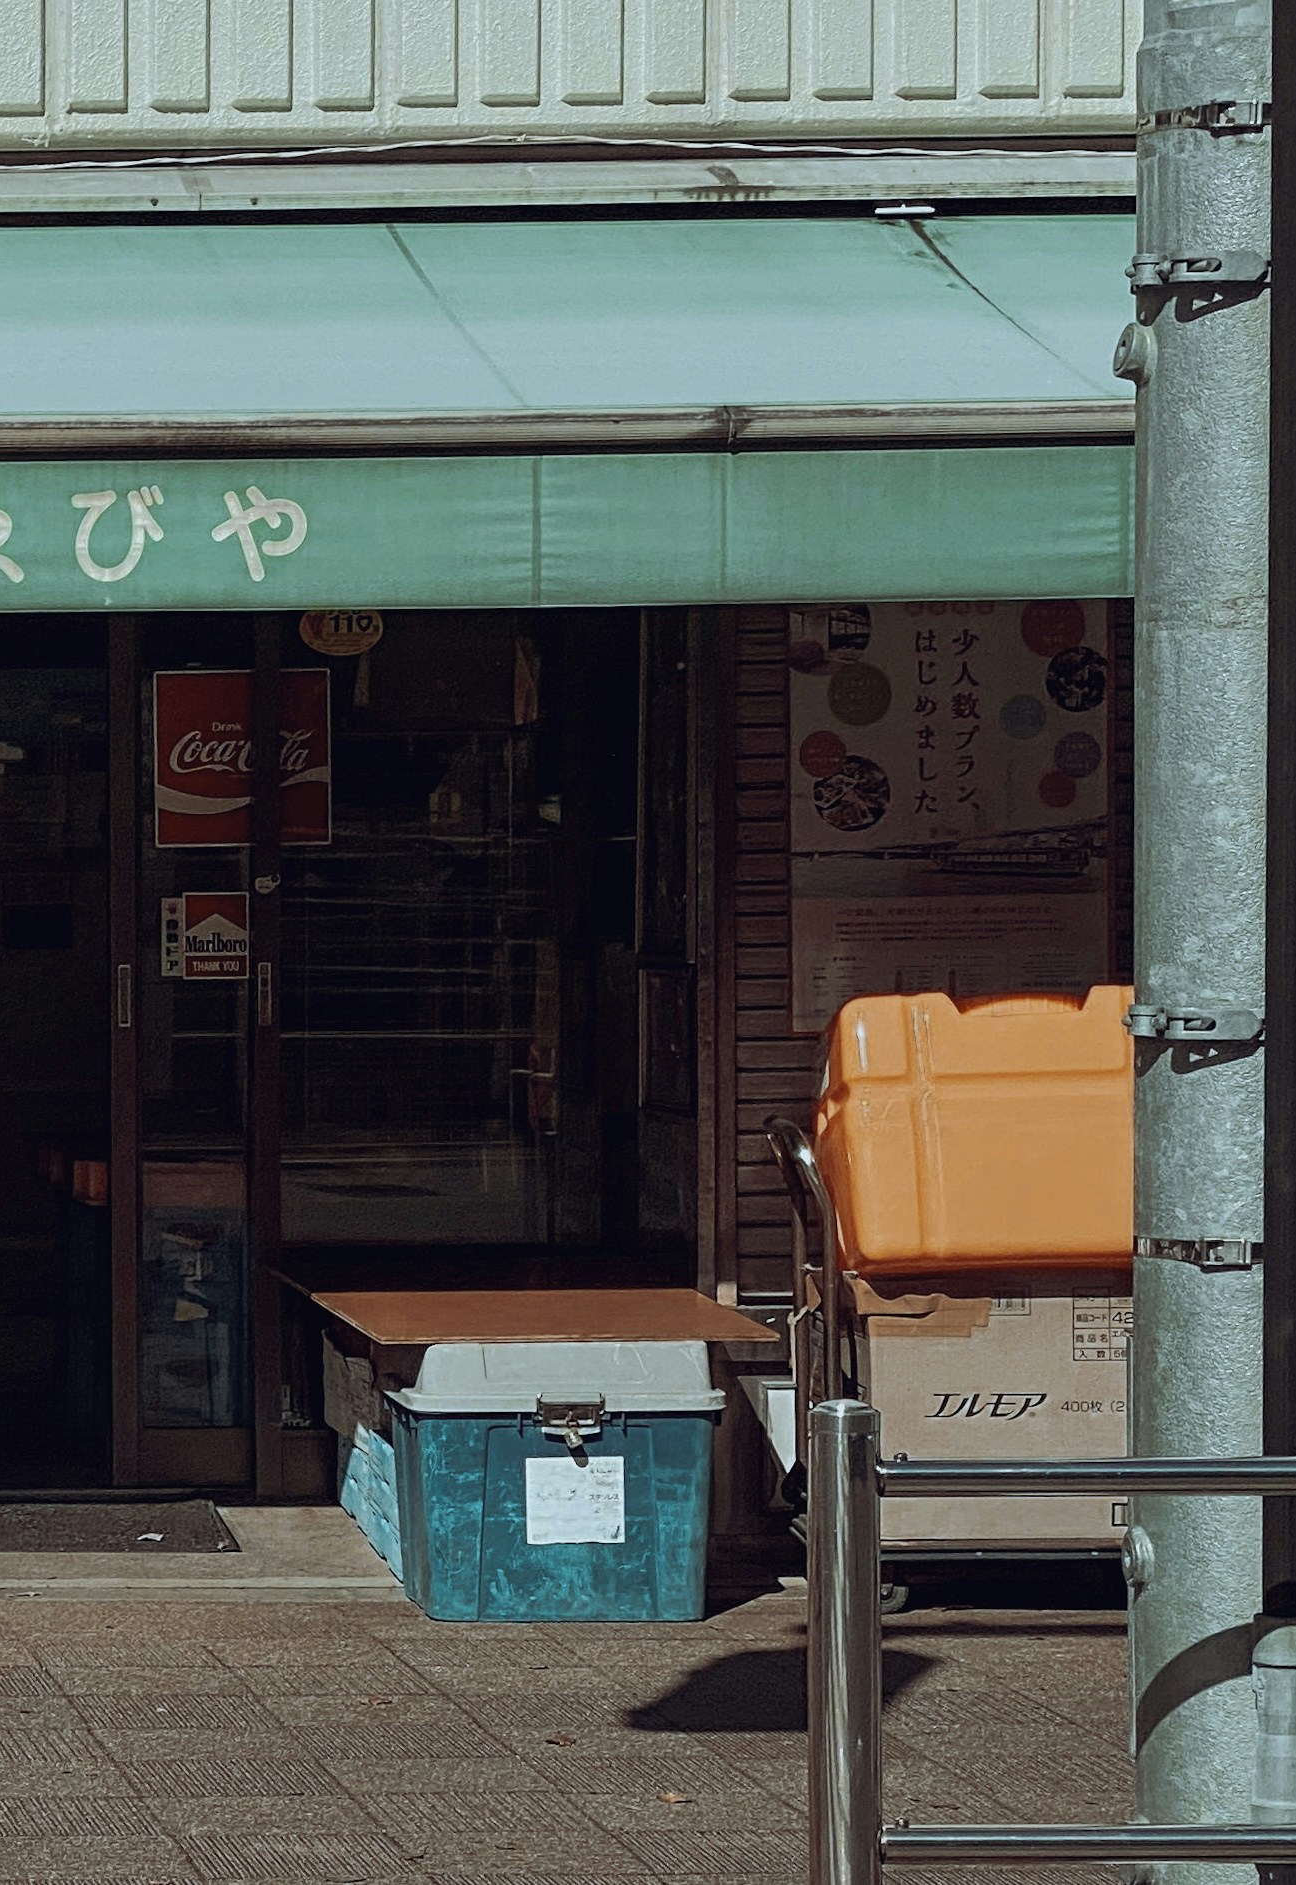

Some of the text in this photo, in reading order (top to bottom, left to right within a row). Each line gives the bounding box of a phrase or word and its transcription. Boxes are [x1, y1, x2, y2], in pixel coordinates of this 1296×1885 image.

[212, 721, 243, 733] Drink
[914, 629, 939, 814] はじめました
[168, 729, 316, 774] Coca-Cla
[185, 932, 247, 953] Marlboro
[191, 960, 240, 972] THANK YOU
[924, 1393, 1048, 1421] エルモア
[1061, 1400, 1104, 1414] 400枚
